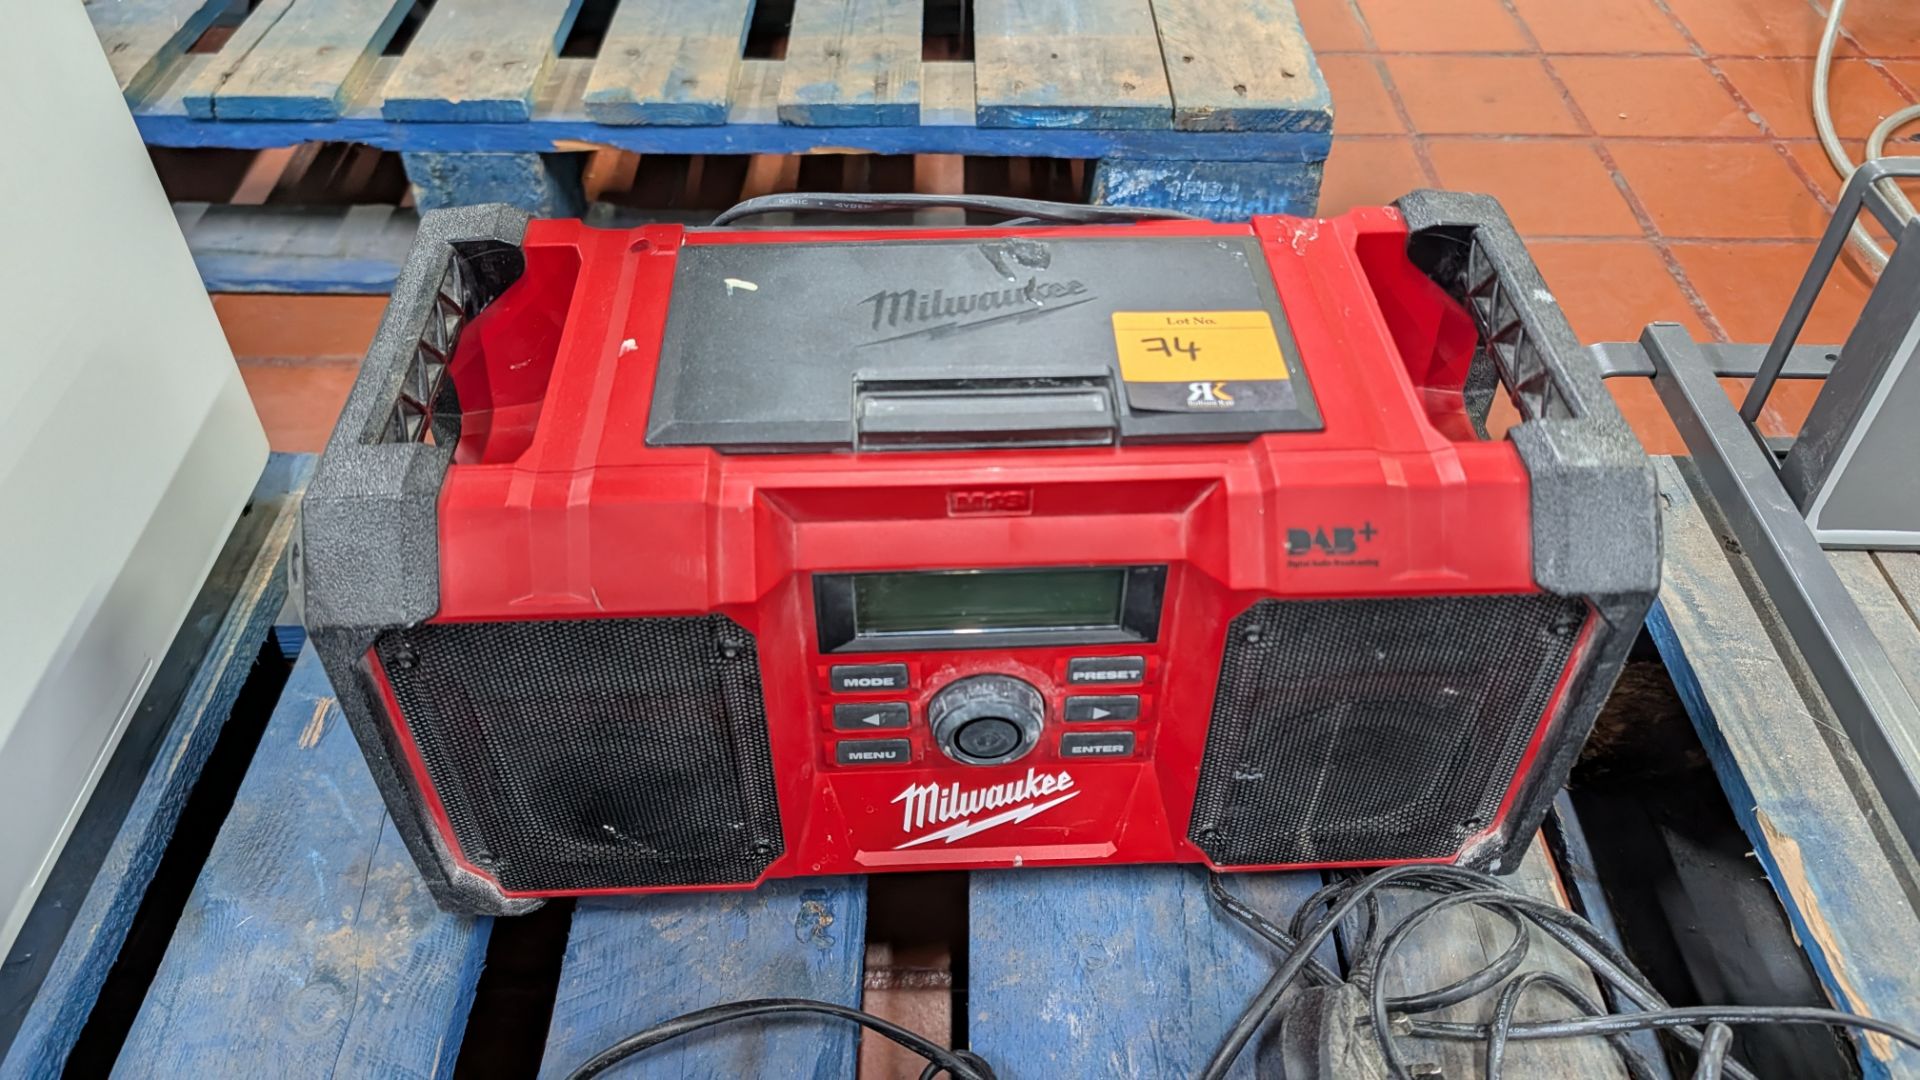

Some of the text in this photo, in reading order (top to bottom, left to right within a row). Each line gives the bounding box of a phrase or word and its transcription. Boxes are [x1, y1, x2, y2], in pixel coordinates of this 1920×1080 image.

[857, 279, 1088, 331] Milwaukee
[1166, 316, 1217, 326] Lot No.
[1140, 336, 1202, 362] 74
[1072, 669, 1140, 681] PRESET
[843, 676, 895, 688] MODE
[848, 749, 897, 760] MENU
[1071, 743, 1124, 755] ENTER
[890, 767, 1075, 833] Milwaukee
